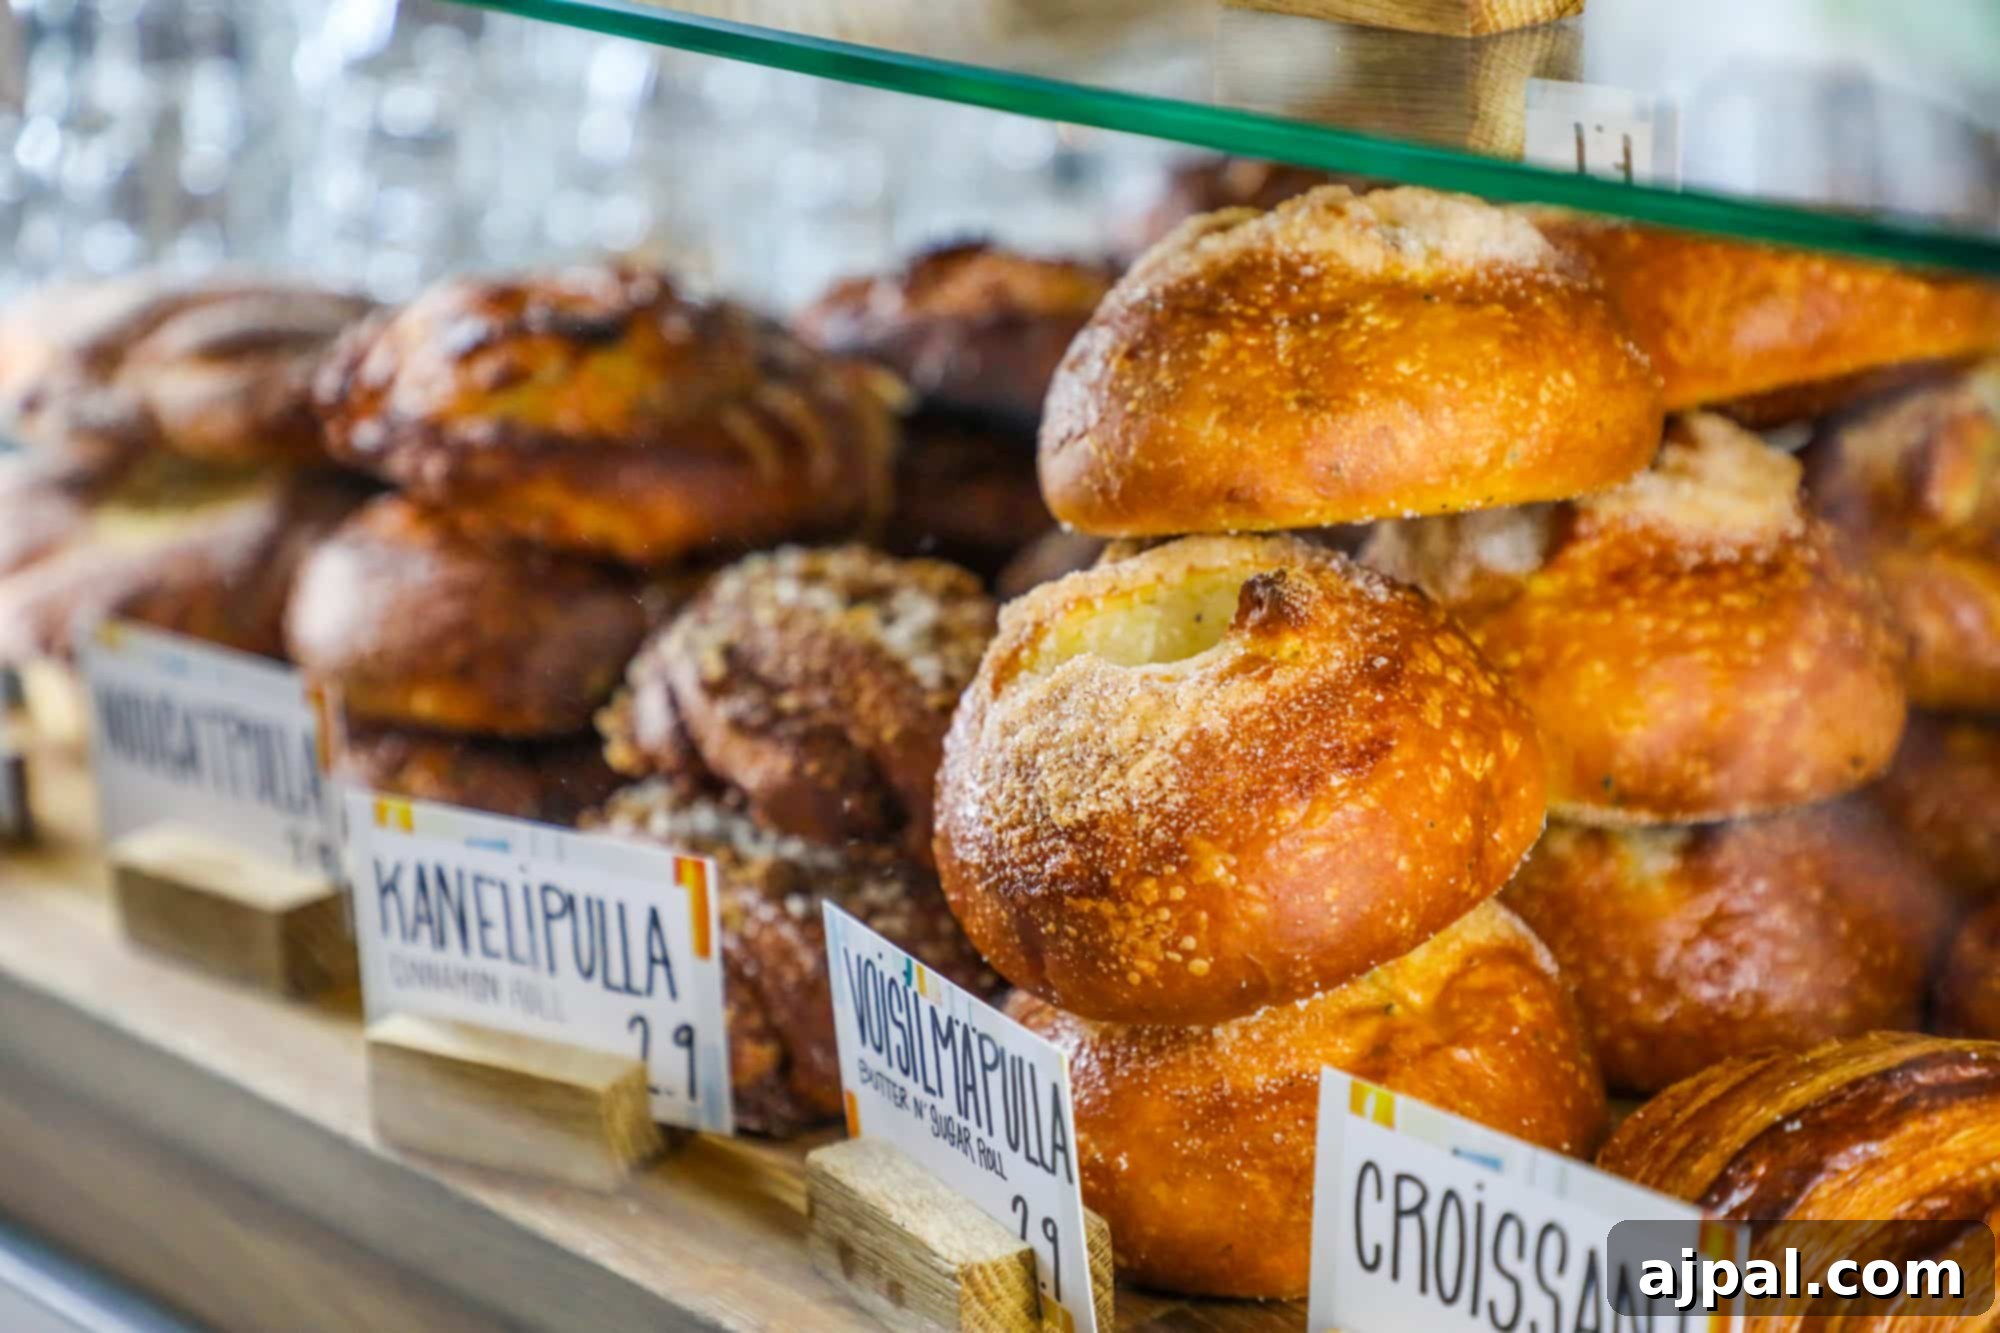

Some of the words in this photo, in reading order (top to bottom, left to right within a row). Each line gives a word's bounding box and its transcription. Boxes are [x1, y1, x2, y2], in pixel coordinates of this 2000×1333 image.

[858, 1058, 910, 1110] BUTTER
[930, 1104, 976, 1164] SUGAR
[976, 1137, 1009, 1181] ROLL
